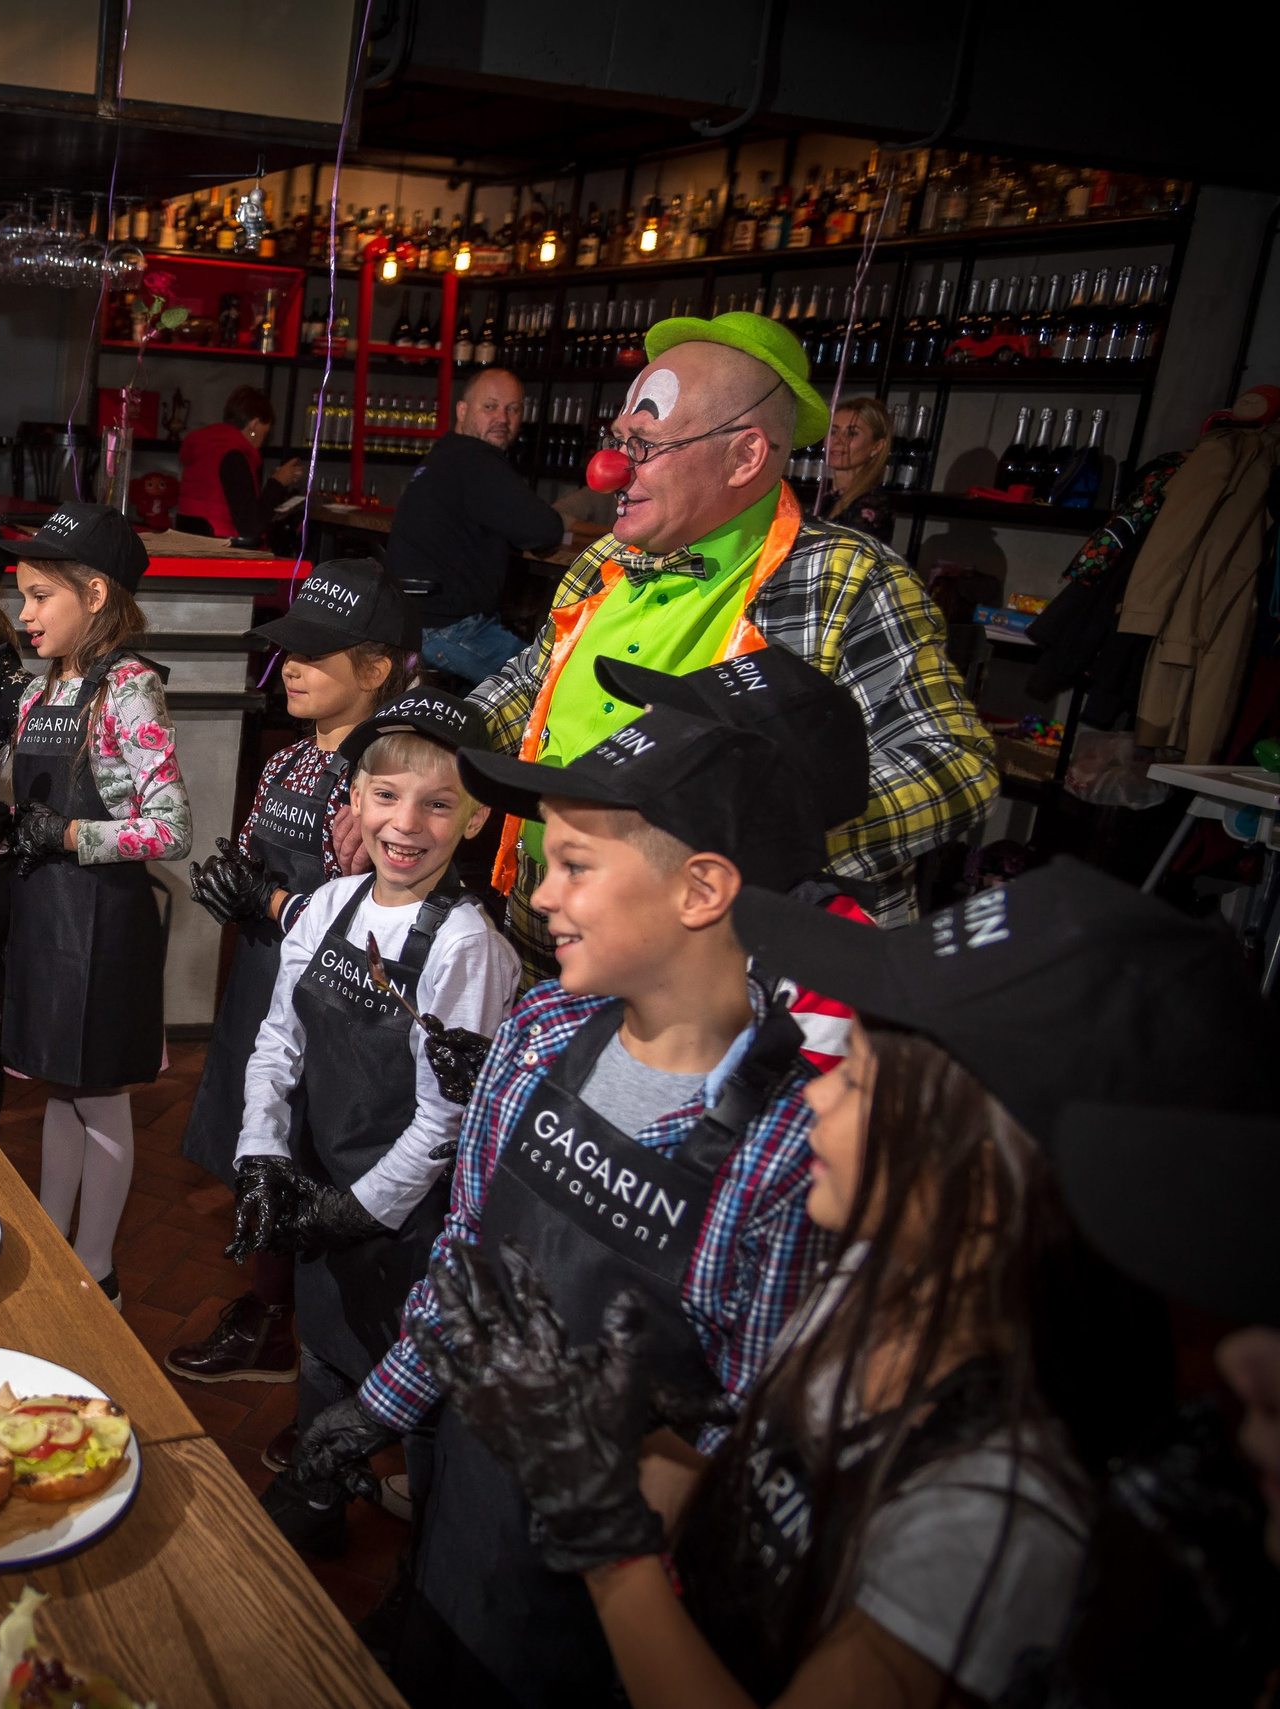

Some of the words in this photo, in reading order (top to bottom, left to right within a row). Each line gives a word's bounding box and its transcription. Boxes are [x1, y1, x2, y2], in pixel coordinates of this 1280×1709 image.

[27, 717, 81, 732] GAGARIN
[375, 698, 467, 725] GAGARIN
[394, 709, 463, 731] aurant
[23, 735, 77, 744] restaurant
[265, 797, 316, 829] GAGARIN
[259, 817, 312, 842] restaurant
[321, 949, 407, 998] GAGARN
[311, 970, 400, 1017] restaurant
[534, 1110, 688, 1228] GAGARIN
[520, 1141, 669, 1250] restaurant
